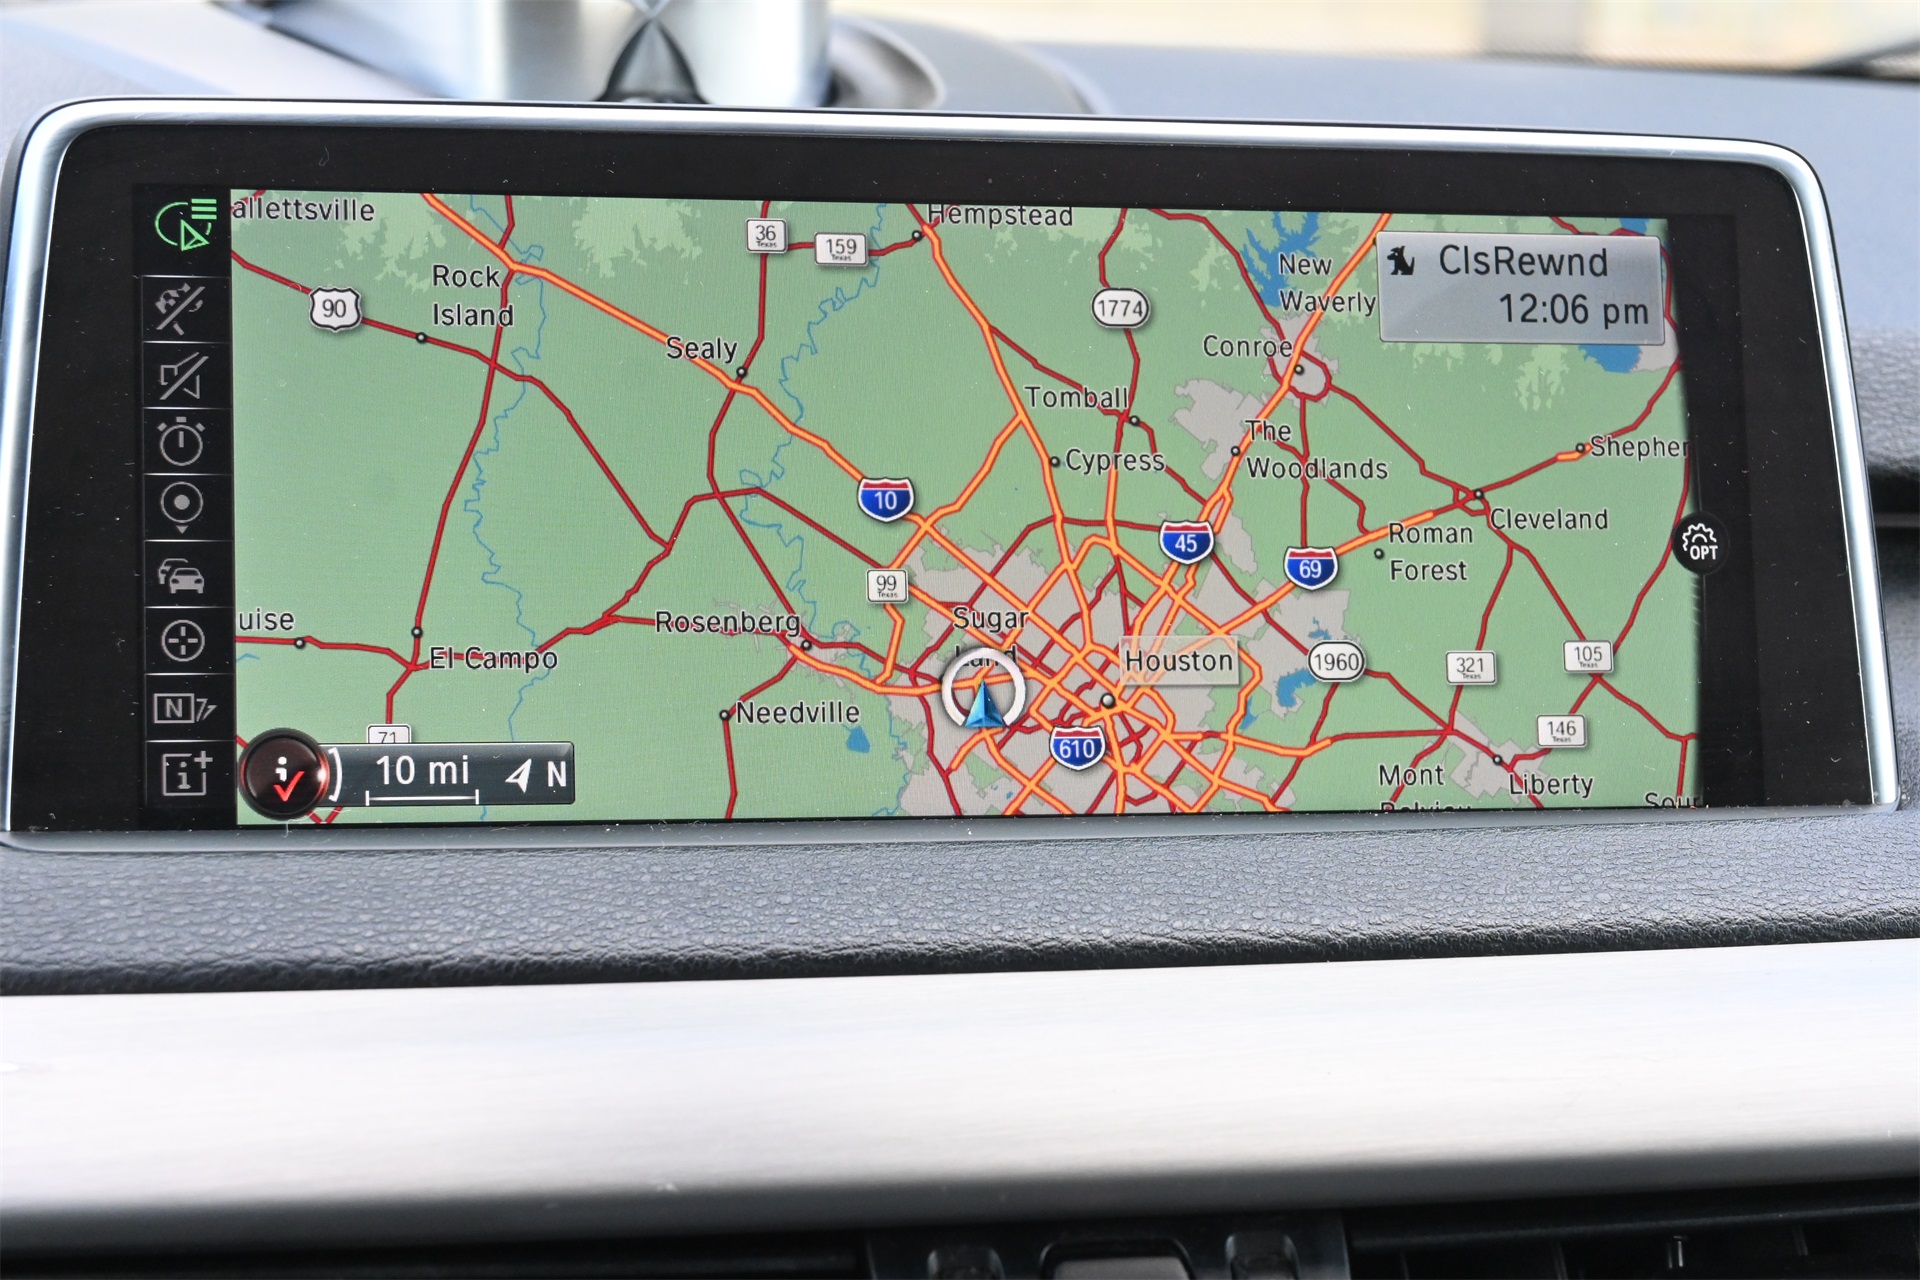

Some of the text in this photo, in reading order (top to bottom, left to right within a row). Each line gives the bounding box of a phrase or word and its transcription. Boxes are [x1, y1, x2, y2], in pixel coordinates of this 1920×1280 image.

[233, 199, 375, 221] allettsville
[928, 204, 1073, 227] Hempstead
[756, 225, 776, 241] 36
[757, 240, 777, 248] Texas
[826, 239, 857, 254] 159
[832, 253, 851, 261] Texas
[1280, 254, 1331, 275] New
[1439, 245, 1608, 276] ClsRewnd
[433, 265, 500, 287] Rock
[322, 299, 346, 318] 90
[1098, 299, 1144, 317] 1774
[1281, 291, 1376, 316] Waverly
[1500, 294, 1649, 329] 12:06 pm
[434, 304, 514, 327] Island
[666, 338, 737, 362] Sealy
[1204, 335, 1292, 357] Conroe
[1025, 387, 1128, 408] Tomball
[1246, 420, 1291, 441] The
[1066, 449, 1164, 473] Cypress
[1248, 457, 1388, 479] Woodlands
[874, 492, 897, 509] 10
[1491, 508, 1609, 530] Cleveland
[1175, 534, 1197, 552] 45
[1390, 523, 1473, 543] Roman
[1690, 545, 1718, 560] OPT
[1299, 559, 1321, 578] 69
[1391, 561, 1467, 580] Forest
[876, 575, 897, 591] 99
[878, 590, 898, 598] Texas
[239, 609, 294, 630] uise
[656, 611, 800, 636] Rosenberg
[954, 607, 1029, 633] Sugar
[430, 647, 558, 675] El Campo
[1126, 650, 1233, 672] Houston
[1314, 653, 1360, 671] 1960
[1575, 646, 1601, 662] 105
[1456, 658, 1484, 673] 321
[737, 702, 860, 725] Needville
[378, 732, 396, 743] 71
[1547, 721, 1576, 737] 146
[1059, 740, 1094, 758] 610
[376, 755, 469, 785] 10 mi
[548, 761, 567, 787] N
[1380, 765, 1443, 785] Mont
[1510, 774, 1593, 796] Liberty
